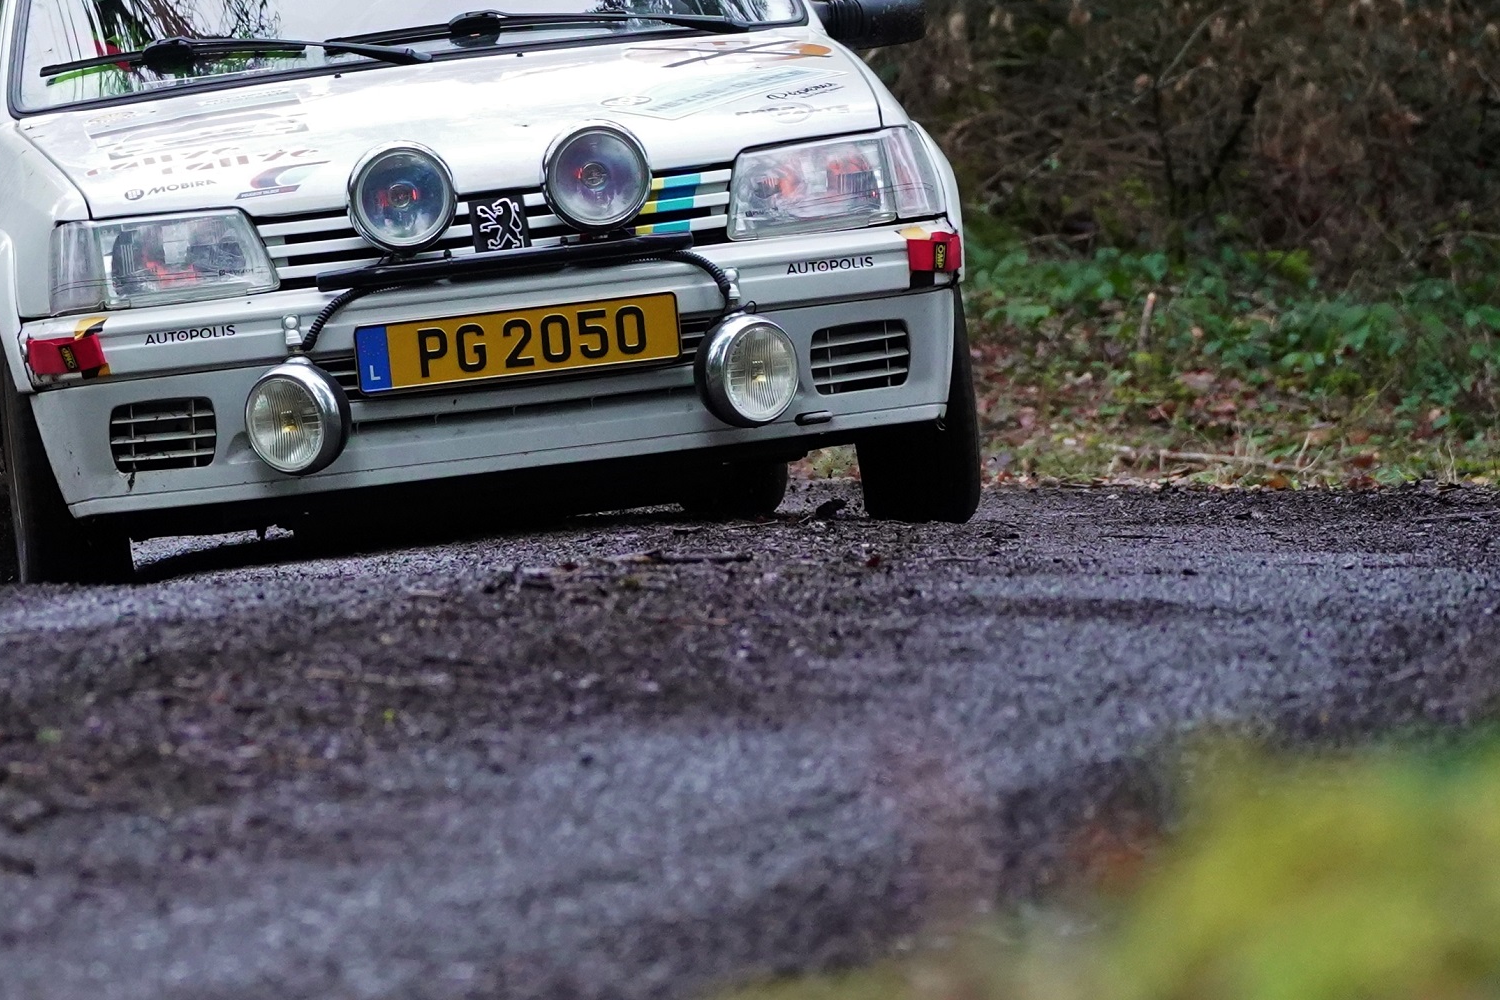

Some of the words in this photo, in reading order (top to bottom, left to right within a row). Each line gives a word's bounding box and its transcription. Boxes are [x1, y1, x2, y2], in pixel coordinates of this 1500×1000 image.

[147, 178, 217, 196] MOBIRA
[787, 256, 874, 275] AUTOPOLIS
[936, 243, 946, 270] OMP
[144, 324, 236, 346] AUTOPOLIS
[369, 364, 381, 381] L
[417, 322, 488, 378] PG
[502, 304, 648, 369] 2050
